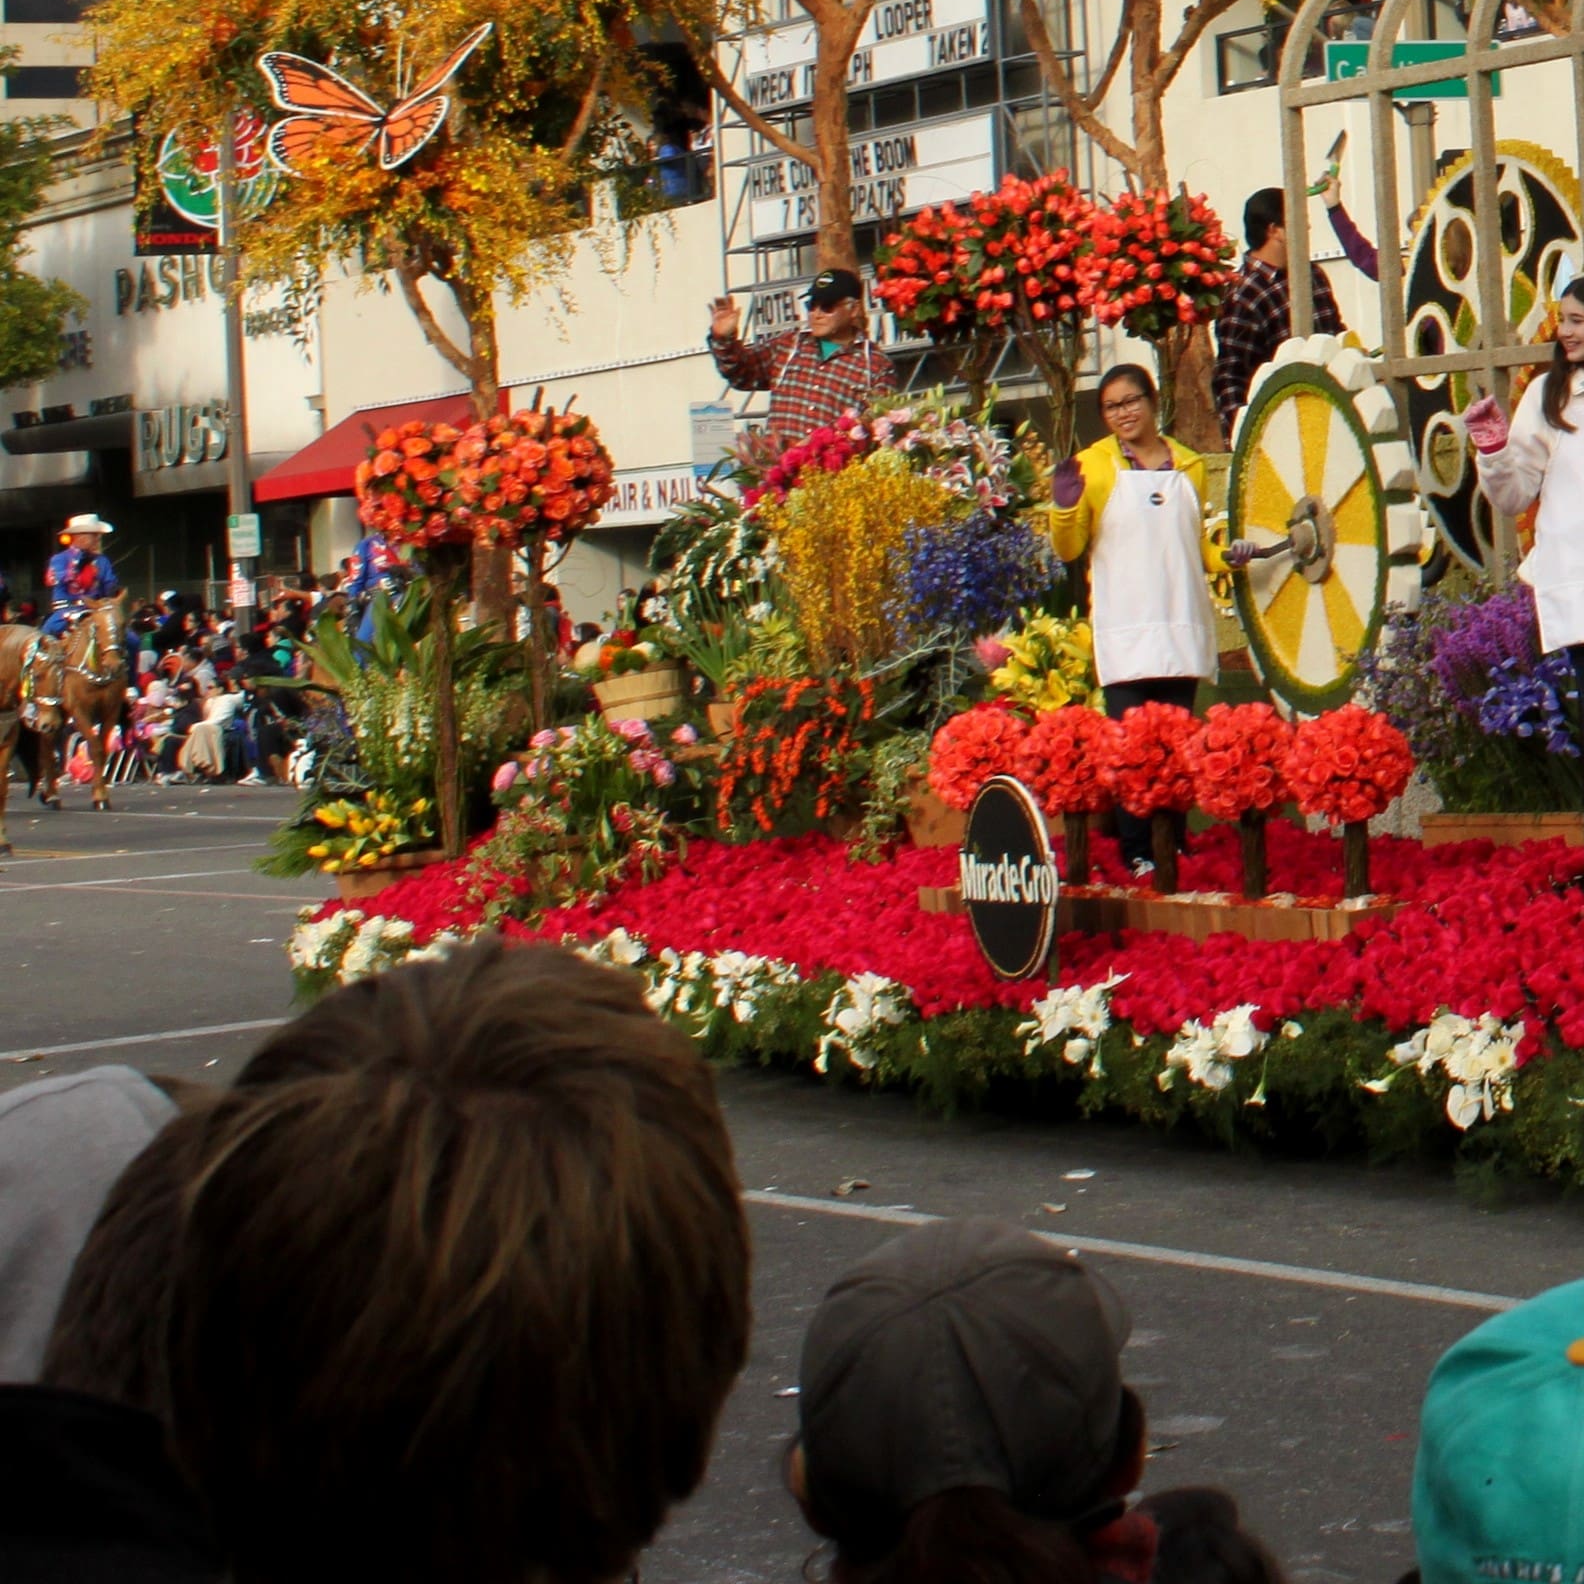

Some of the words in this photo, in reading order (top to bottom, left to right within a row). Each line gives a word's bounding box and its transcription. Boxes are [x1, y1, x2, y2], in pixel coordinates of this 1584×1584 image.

[928, 23, 978, 66] TAKEN
[749, 69, 797, 108] WRECK
[752, 160, 787, 198] HERE
[851, 144, 871, 179] HE
[873, 136, 918, 173] BOOM
[782, 198, 791, 232] 7
[798, 176, 908, 228] PSOPATHS
[139, 399, 229, 472] RUGS
[642, 479, 651, 510] &
